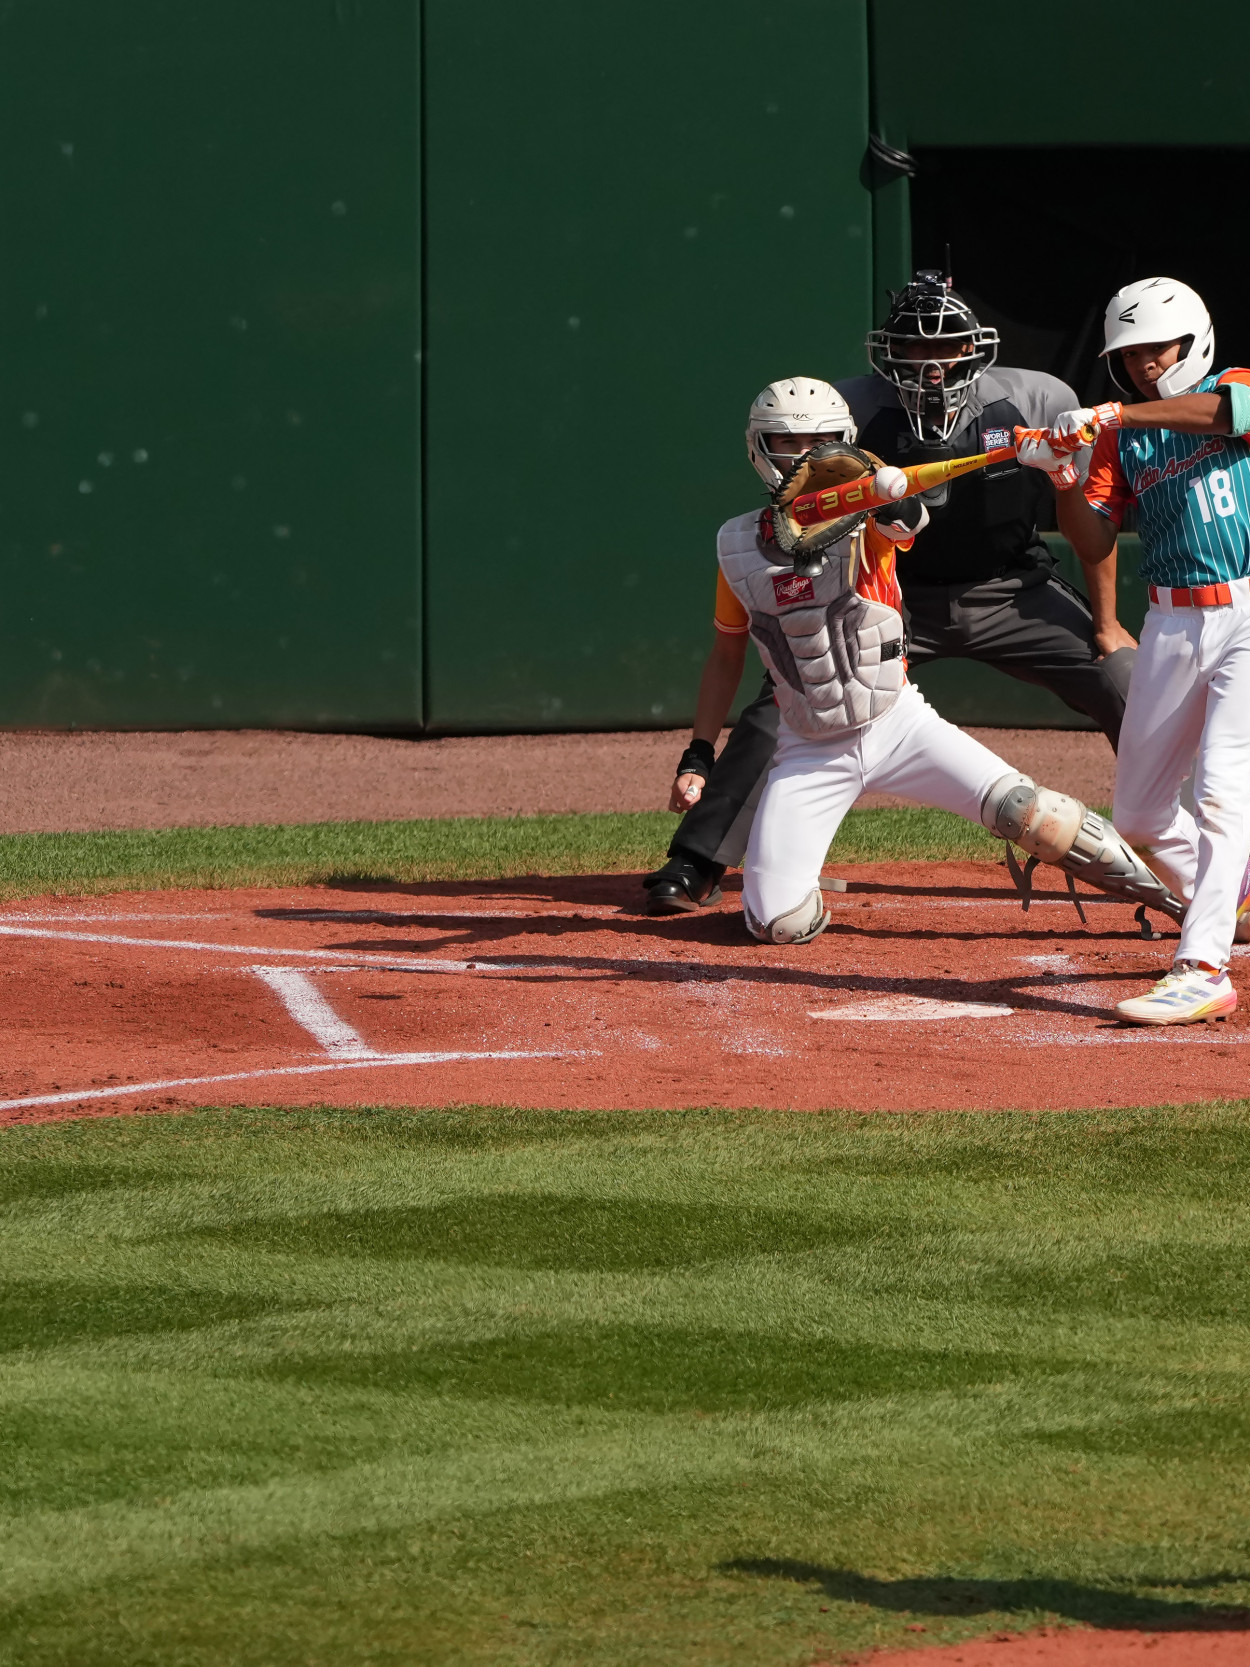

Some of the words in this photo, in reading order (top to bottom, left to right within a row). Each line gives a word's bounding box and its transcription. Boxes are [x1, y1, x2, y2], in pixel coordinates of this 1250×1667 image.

[984, 431, 1009, 441] WORLD
[985, 437, 1009, 446] SERIES
[1133, 465, 1160, 496] Latin
[1160, 437, 1224, 481] America
[1188, 468, 1236, 523] 18
[776, 578, 810, 596] Rawlings
